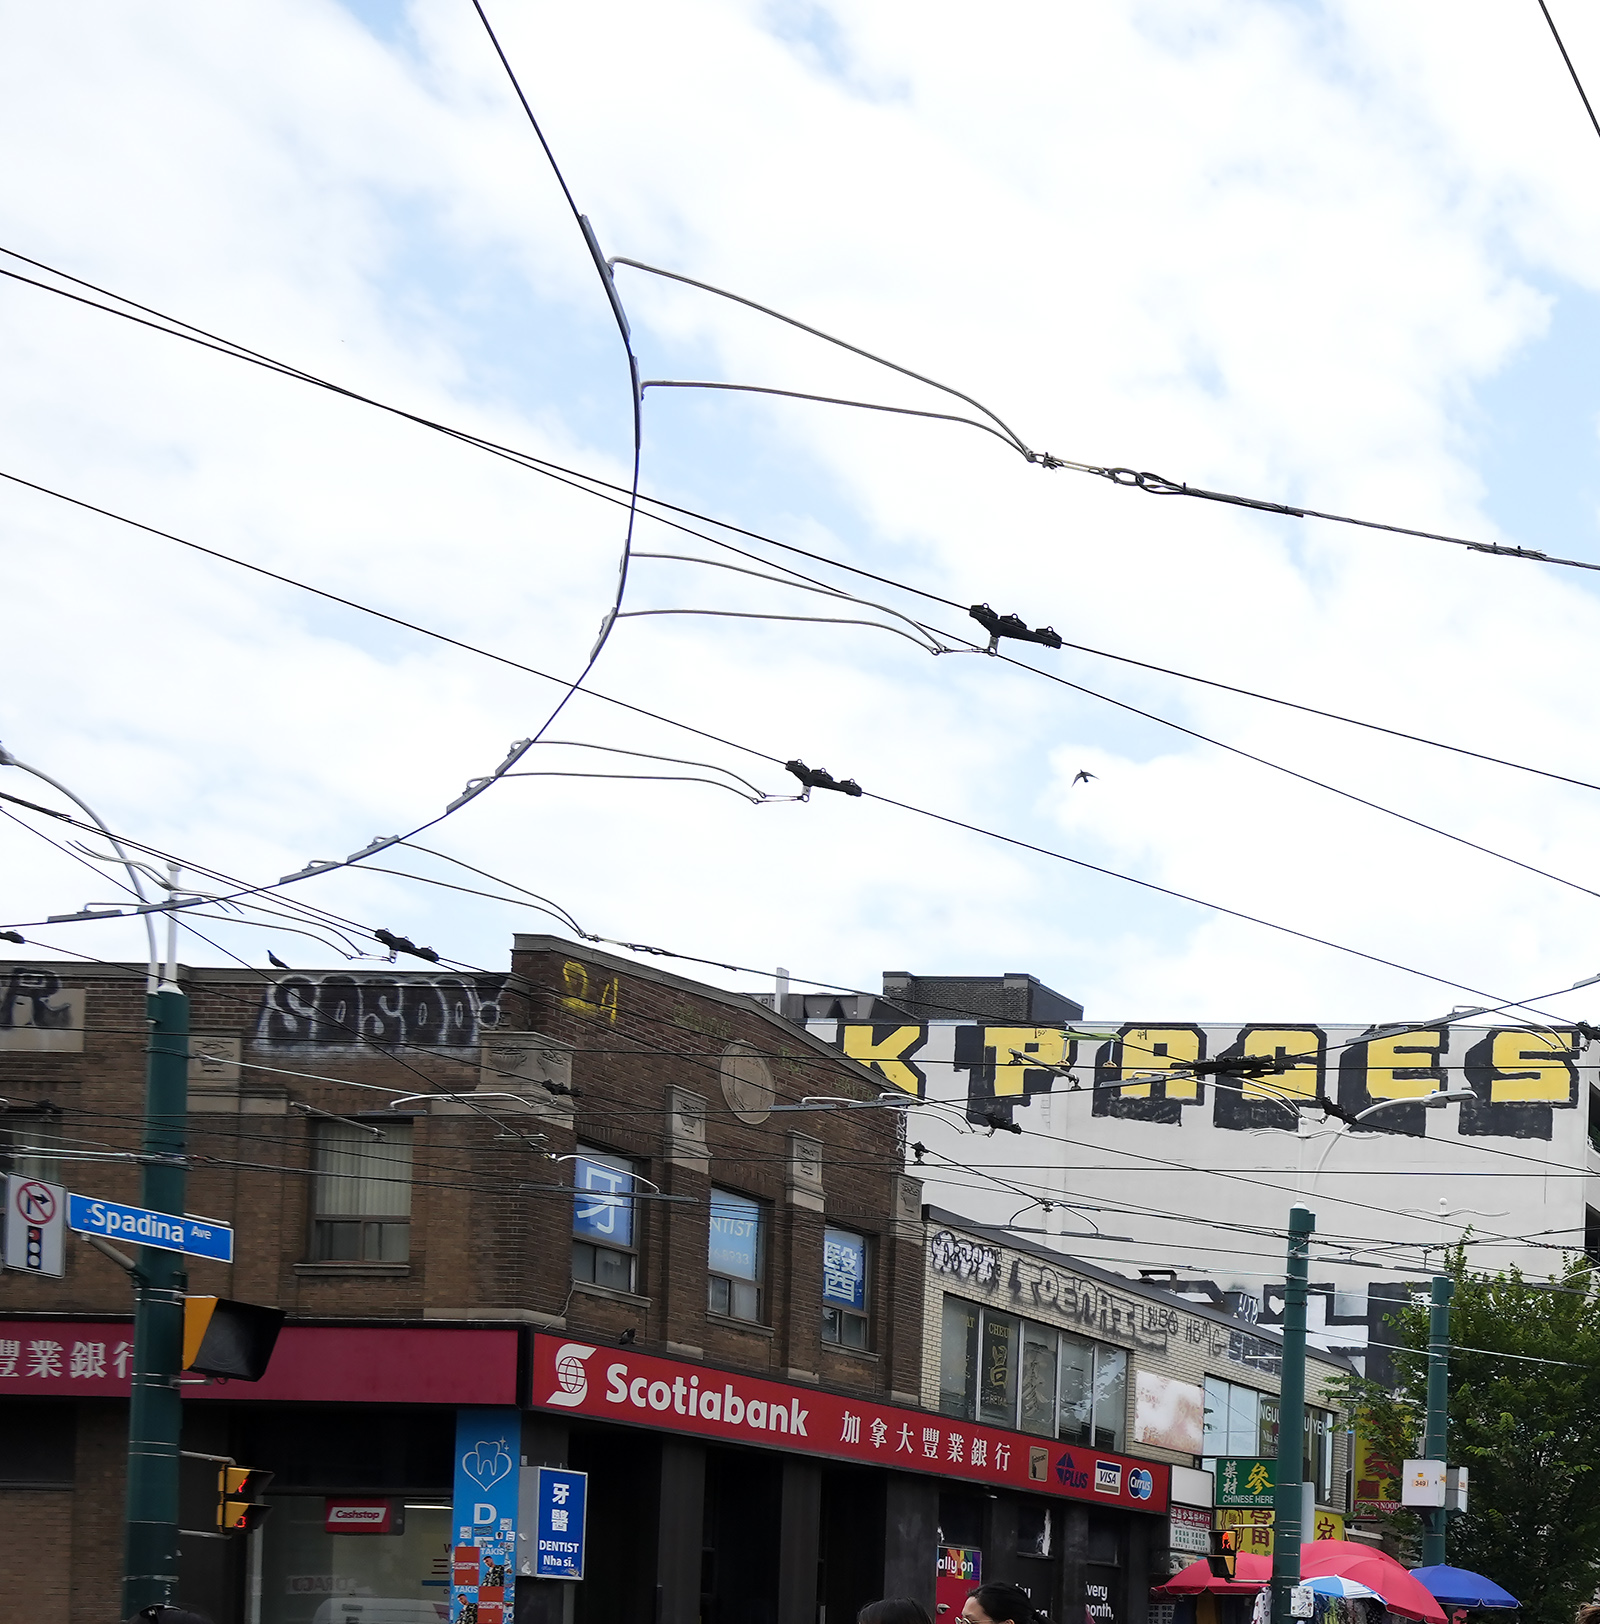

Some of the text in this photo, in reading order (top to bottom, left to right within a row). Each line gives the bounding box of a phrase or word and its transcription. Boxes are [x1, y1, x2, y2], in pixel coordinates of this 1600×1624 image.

[577, 1167, 622, 1234] 牙
[90, 1203, 212, 1243] Spadina Ave
[606, 1363, 809, 1437] Scotiabank
[839, 1410, 1011, 1471] 加拿大豐業銀行
[1063, 1469, 1088, 1489] PLUS
[1100, 1471, 1117, 1484] VISA
[1130, 1476, 1150, 1490] Cirrus
[1222, 1495, 1254, 1504] CHINESE
[551, 1483, 570, 1532] 牙醫
[335, 1510, 380, 1520] Cashstop
[480, 1547, 505, 1555] TAKIS
[539, 1540, 580, 1553] DENTIST
[543, 1555, 562, 1567] Nha
[960, 1561, 974, 1573] on
[455, 1586, 479, 1594] TAKIS
